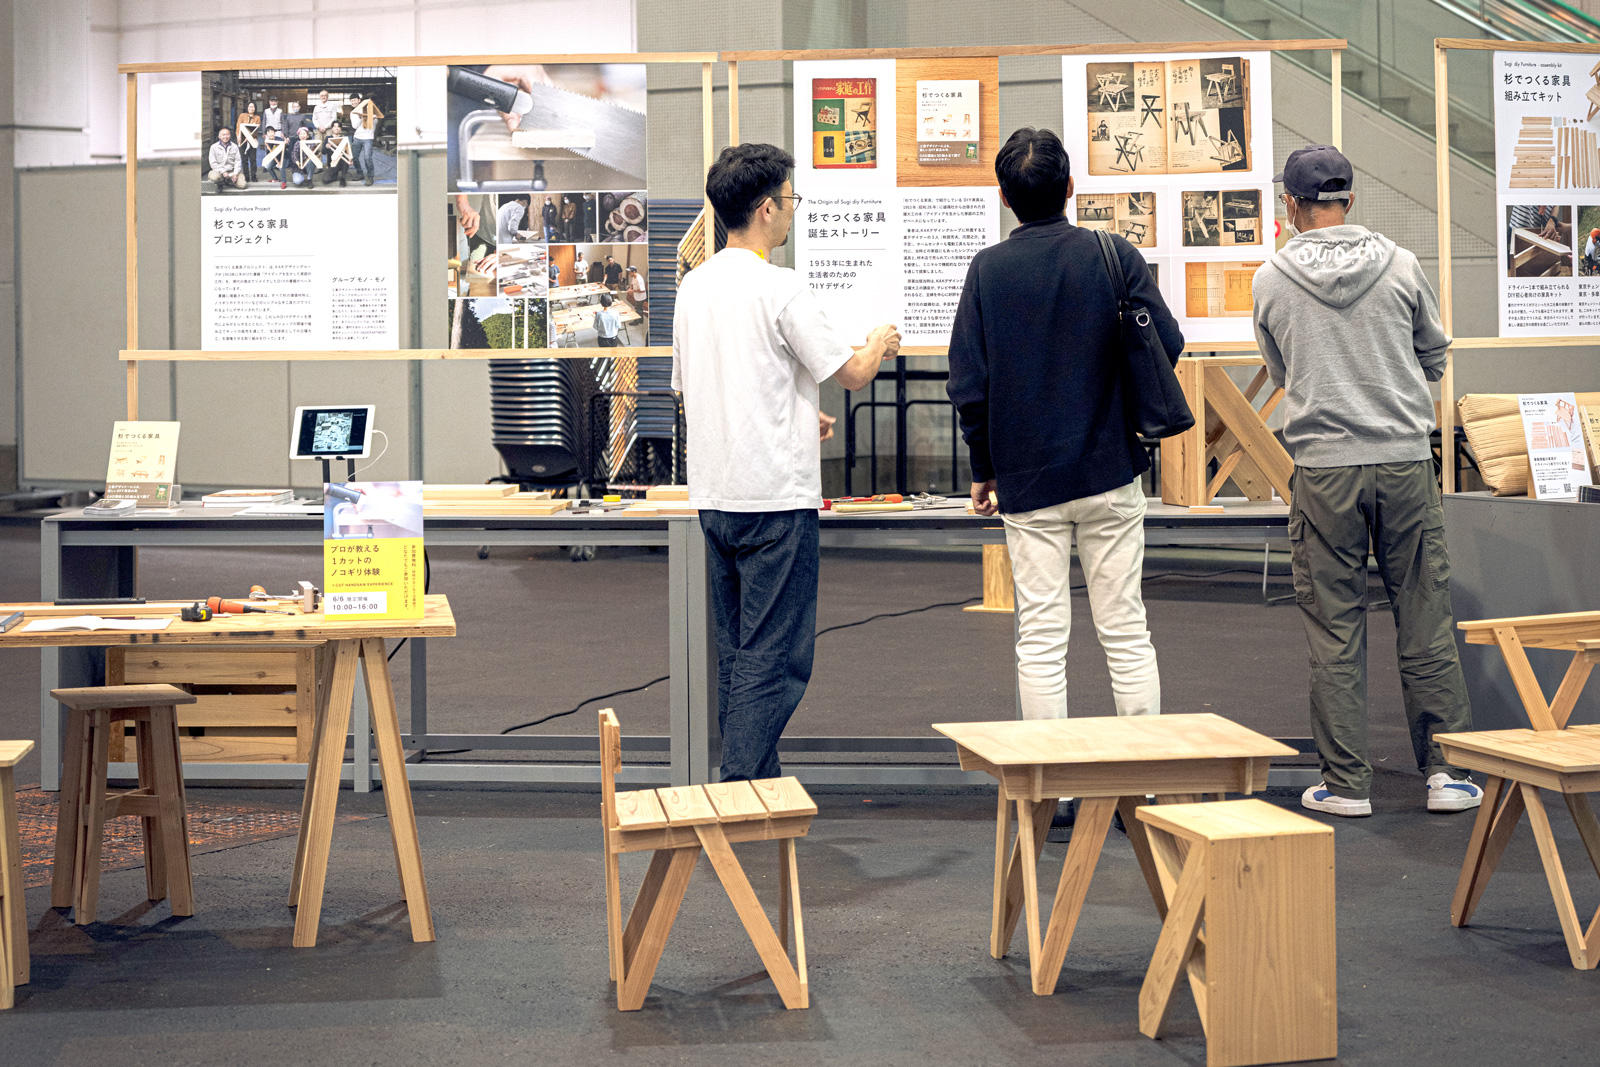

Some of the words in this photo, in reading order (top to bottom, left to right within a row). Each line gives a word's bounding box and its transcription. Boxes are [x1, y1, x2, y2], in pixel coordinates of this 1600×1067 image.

[1504, 73, 1571, 86] 杉でつくる家具
[1504, 90, 1562, 102] 組み立てキット
[808, 212, 886, 223] 杉でつくる家具
[214, 219, 288, 229] 杉でつくる家具
[808, 228, 880, 238] 誕生ストーリー
[214, 235, 272, 244] プロジェクト
[331, 544, 380, 553] プロが教える
[331, 568, 380, 576] ノコギリ体験
